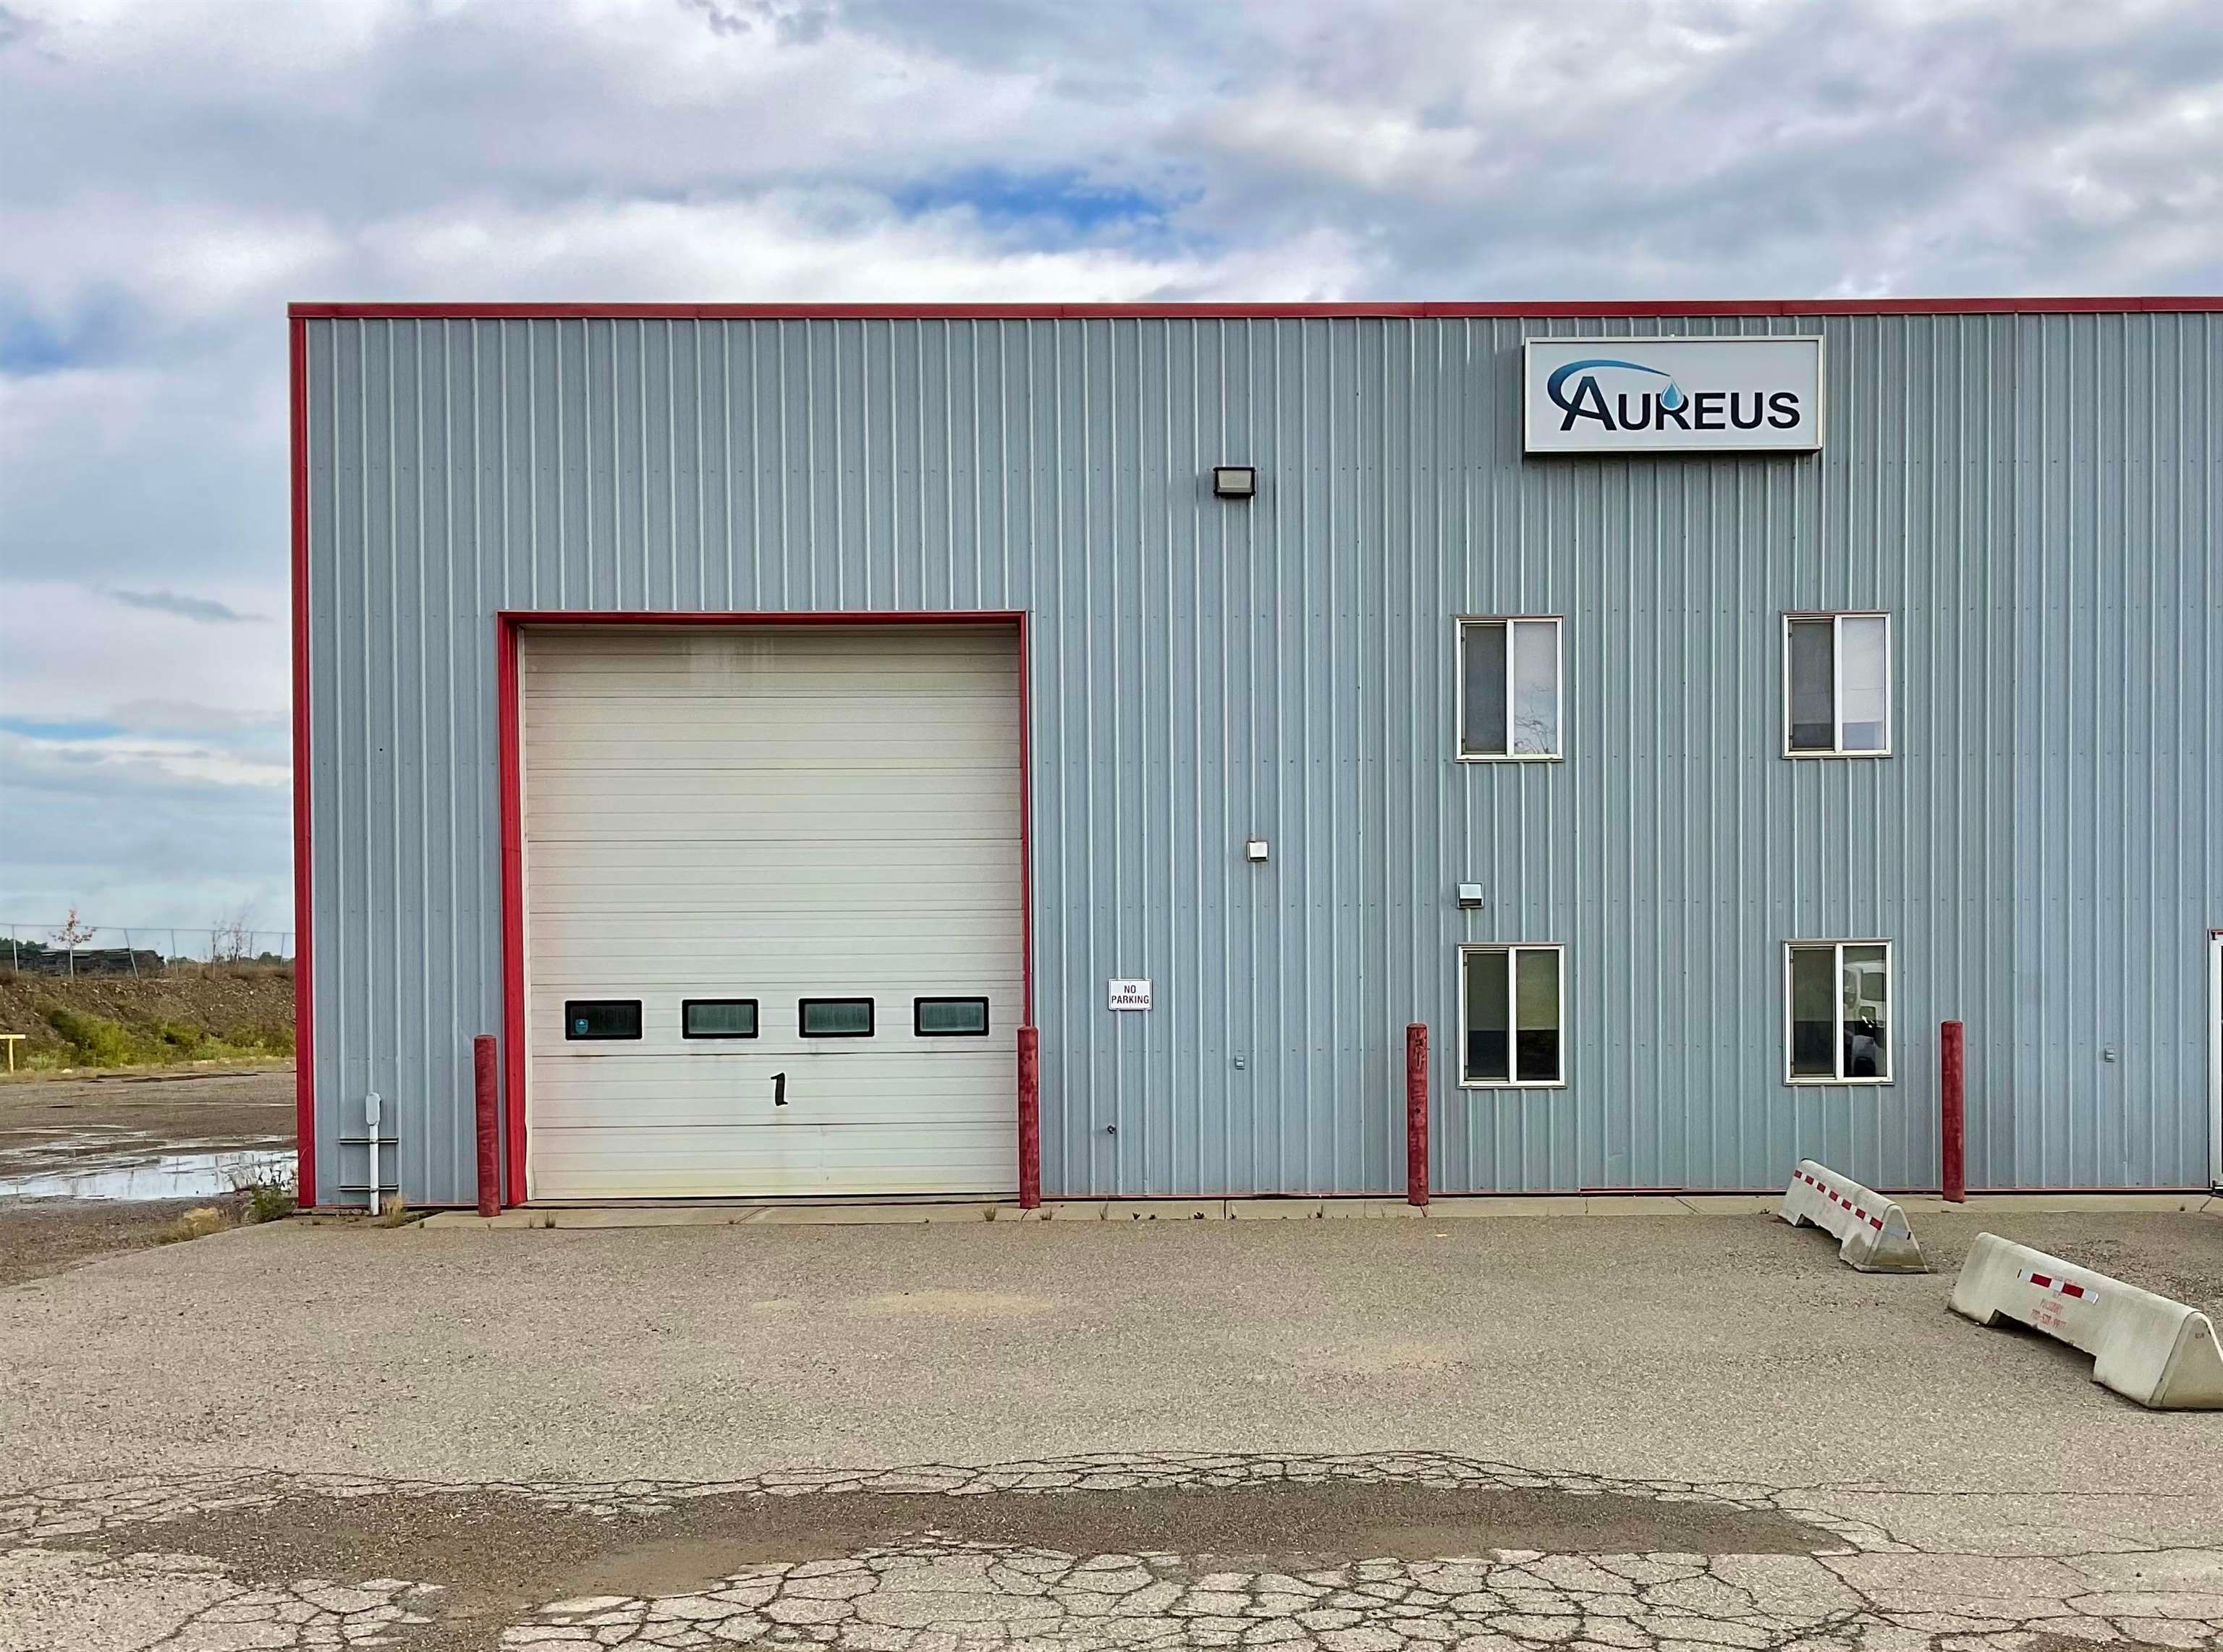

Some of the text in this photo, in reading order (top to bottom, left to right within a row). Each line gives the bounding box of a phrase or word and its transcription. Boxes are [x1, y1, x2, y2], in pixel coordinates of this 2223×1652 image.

[1559, 376, 1800, 431] AUREUS
[1111, 995, 1150, 1004] PARKING
[1124, 985, 1137, 994] NO
[770, 1072, 789, 1106] 1
